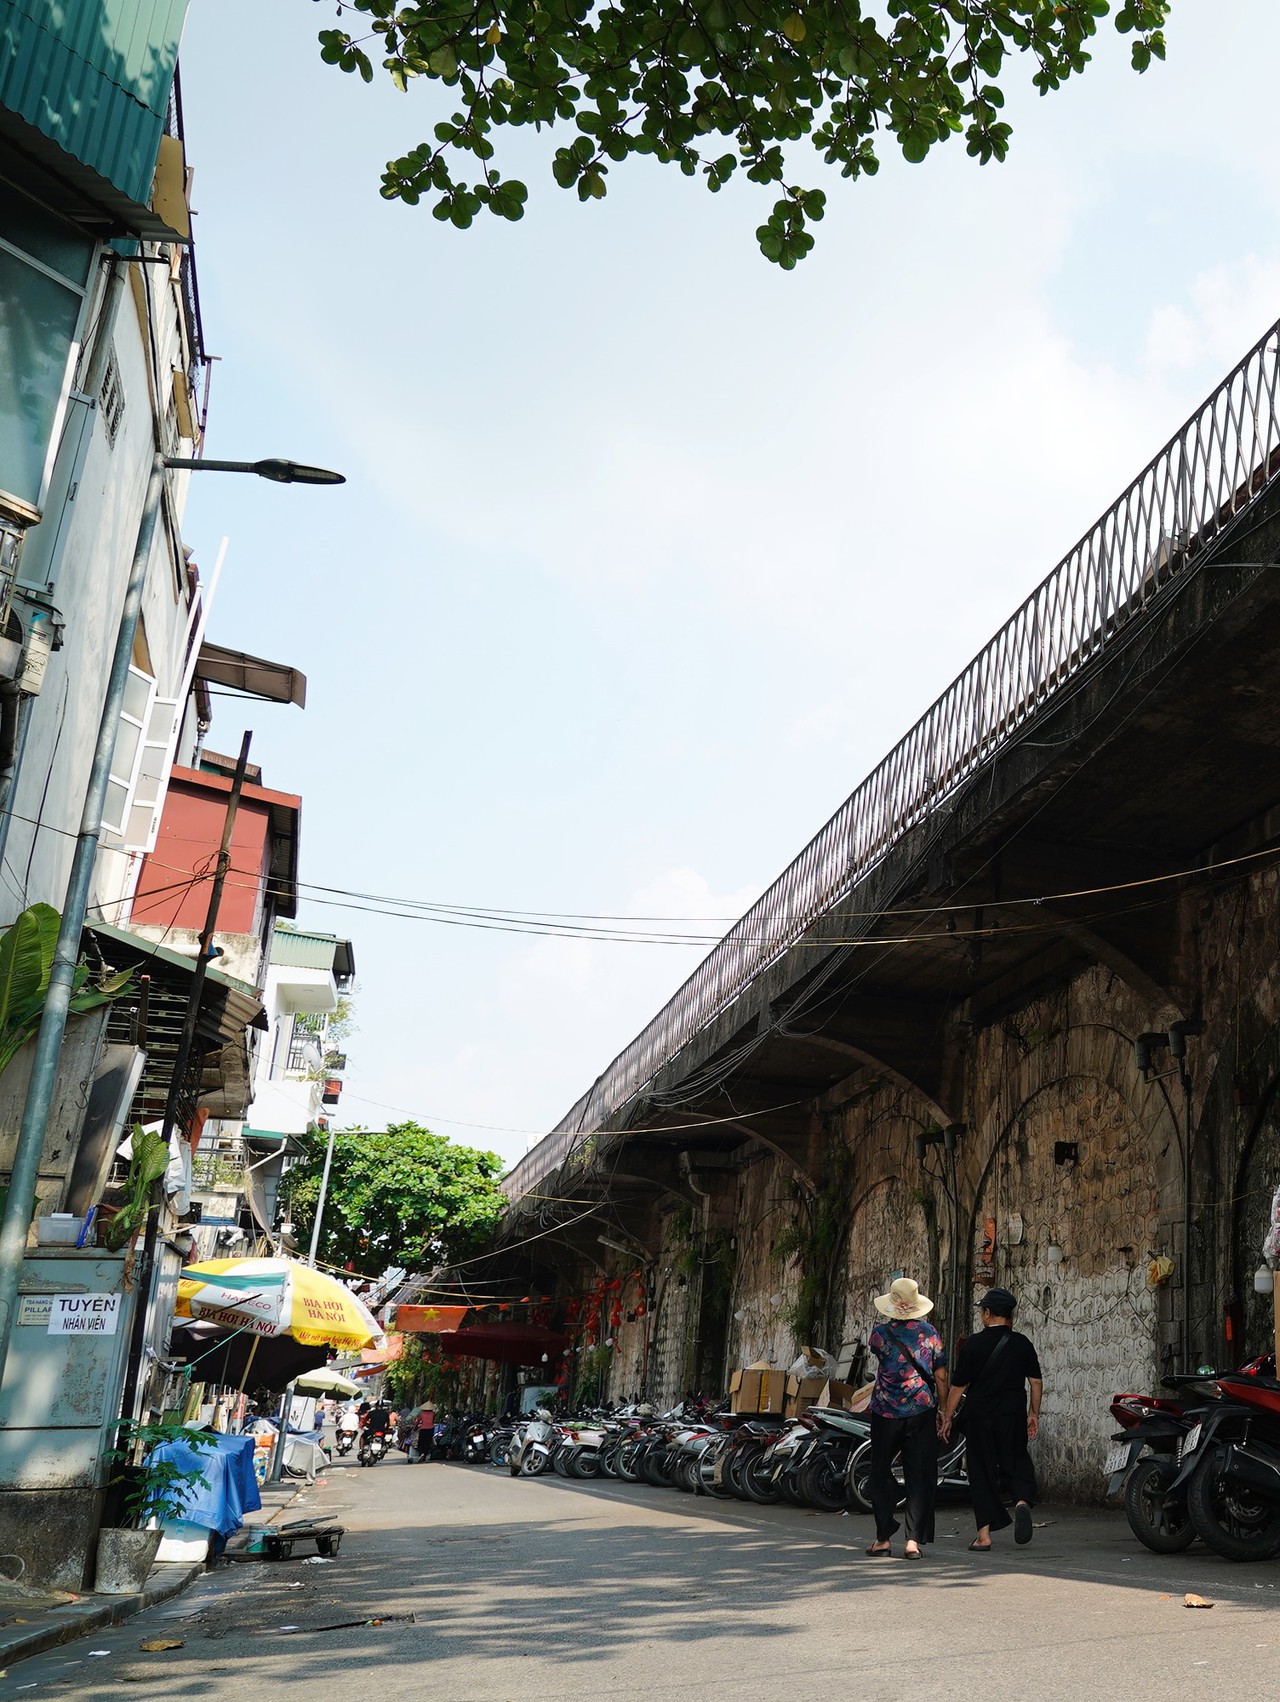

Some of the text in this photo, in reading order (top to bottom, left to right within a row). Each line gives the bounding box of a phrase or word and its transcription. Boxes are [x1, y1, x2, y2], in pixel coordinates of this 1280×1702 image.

[303, 1297, 321, 1308] BIA
[198, 1307, 216, 1319] BIA
[256, 1321, 277, 1335] NỘI
[308, 1308, 346, 1324] HÀ NỘI
